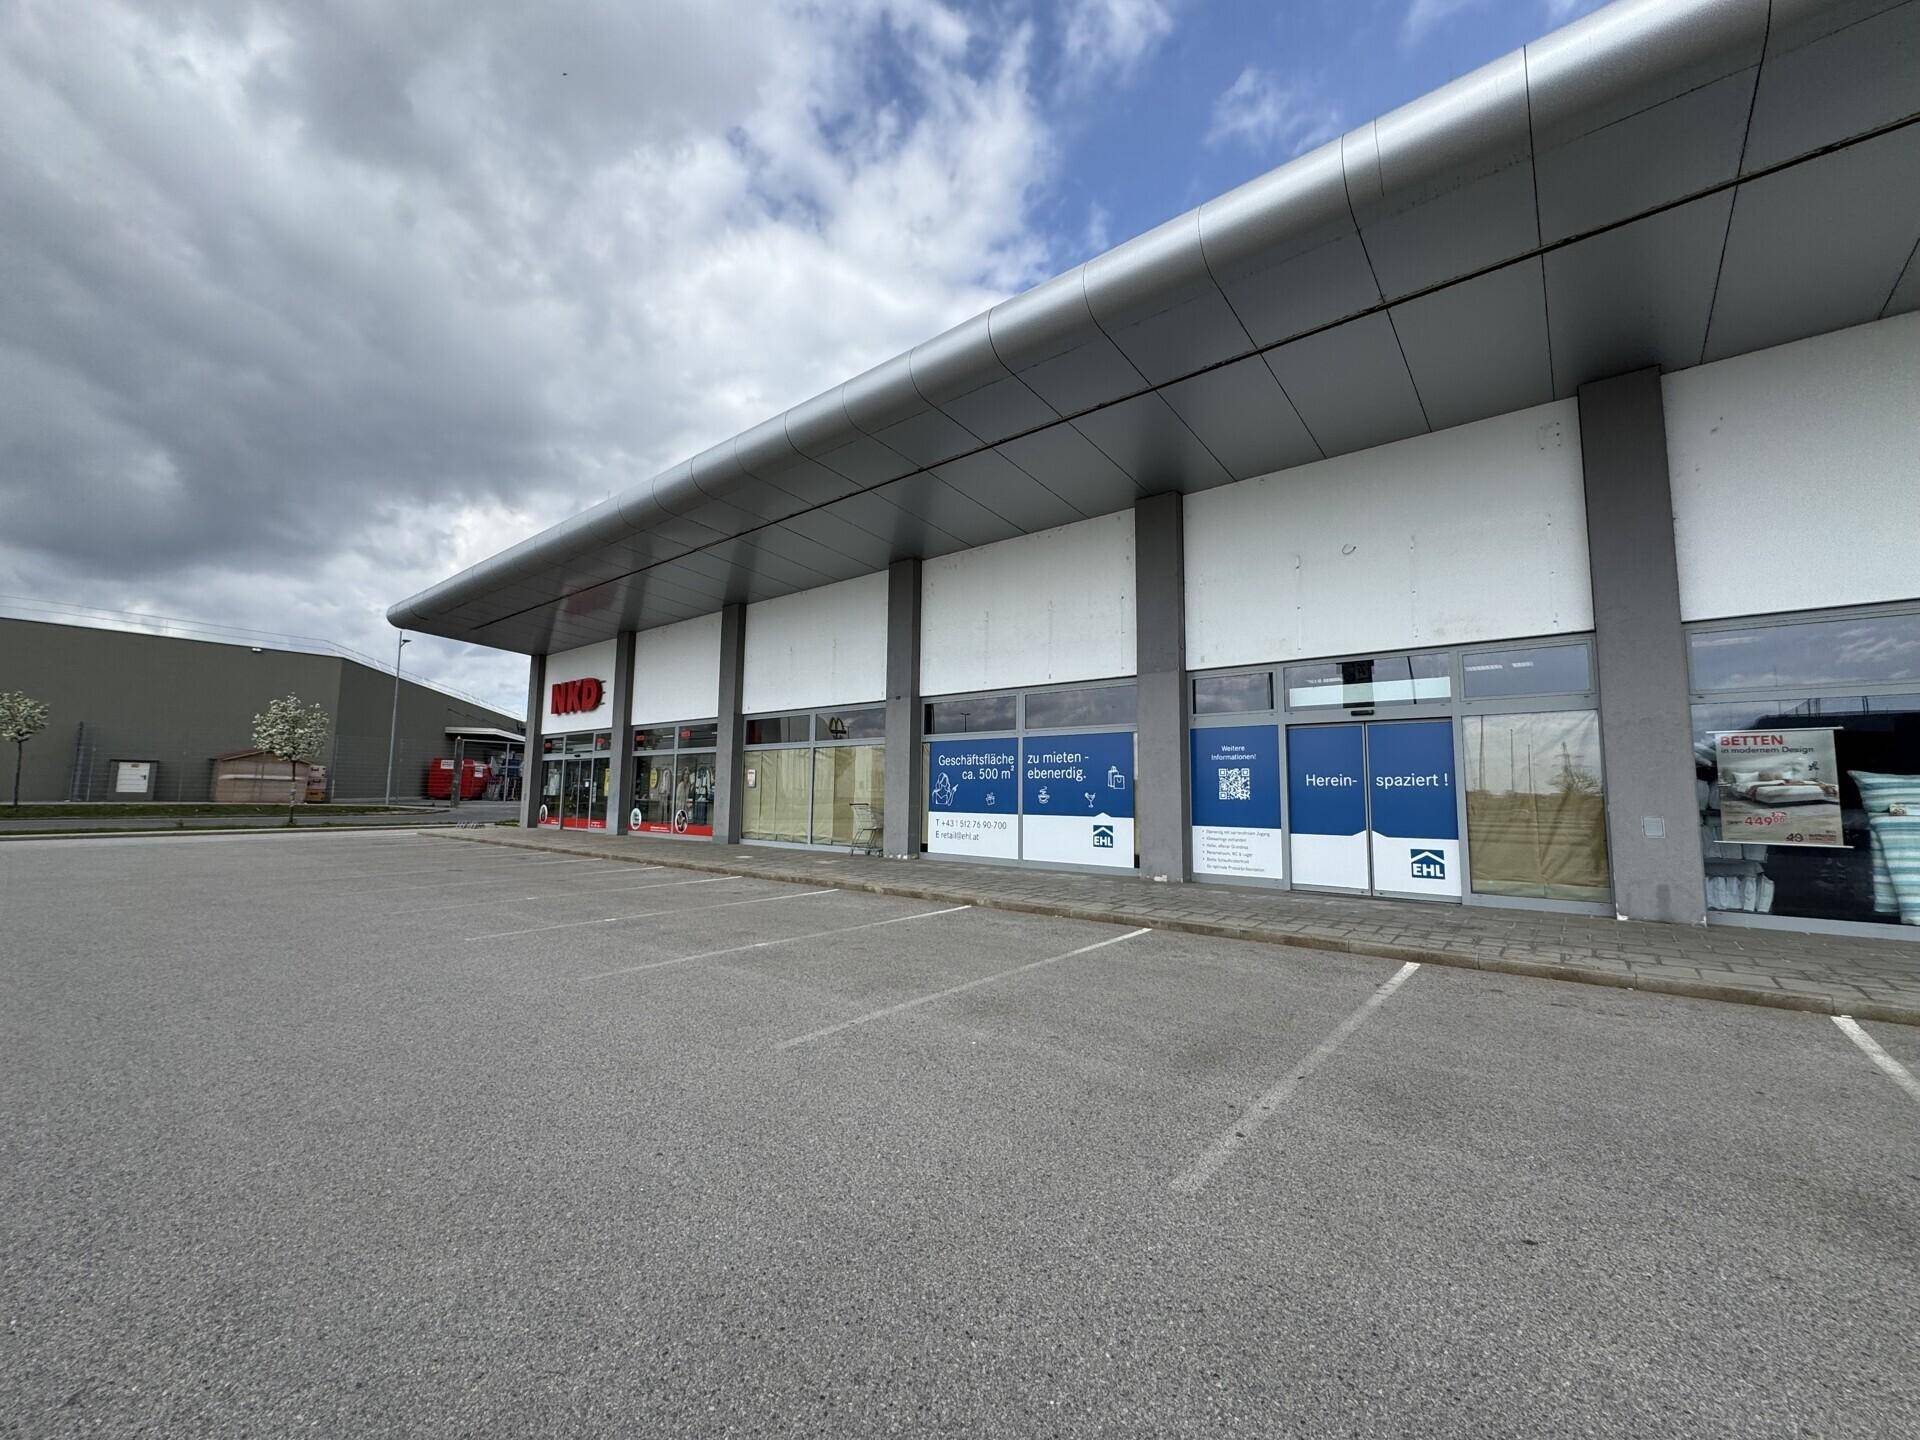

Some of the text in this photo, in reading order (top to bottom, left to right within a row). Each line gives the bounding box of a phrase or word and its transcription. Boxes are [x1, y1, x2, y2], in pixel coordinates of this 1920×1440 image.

[551, 677, 603, 716] NKD
[1721, 735, 1783, 746] BETTEN
[1731, 746, 1780, 754] modernem
[1782, 746, 1814, 754] Design
[938, 753, 1015, 766] Geschäftsfläche
[1027, 755, 1040, 763] zu
[1043, 751, 1081, 763] mieten
[1211, 753, 1257, 761] Informationen!
[961, 771, 977, 780] ca.
[979, 768, 998, 780] 500
[1027, 766, 1087, 783] ebenerdig.
[1305, 773, 1358, 787] Herein-
[1375, 772, 1438, 790] spaziert
[935, 818, 940, 826] T
[941, 819, 954, 827] +43
[960, 820, 971, 828] 512
[972, 821, 981, 829] 76
[982, 821, 1007, 830] 90-700
[935, 830, 940, 839] E
[1093, 836, 1113, 847] EHL
[1412, 863, 1444, 878] EHL
